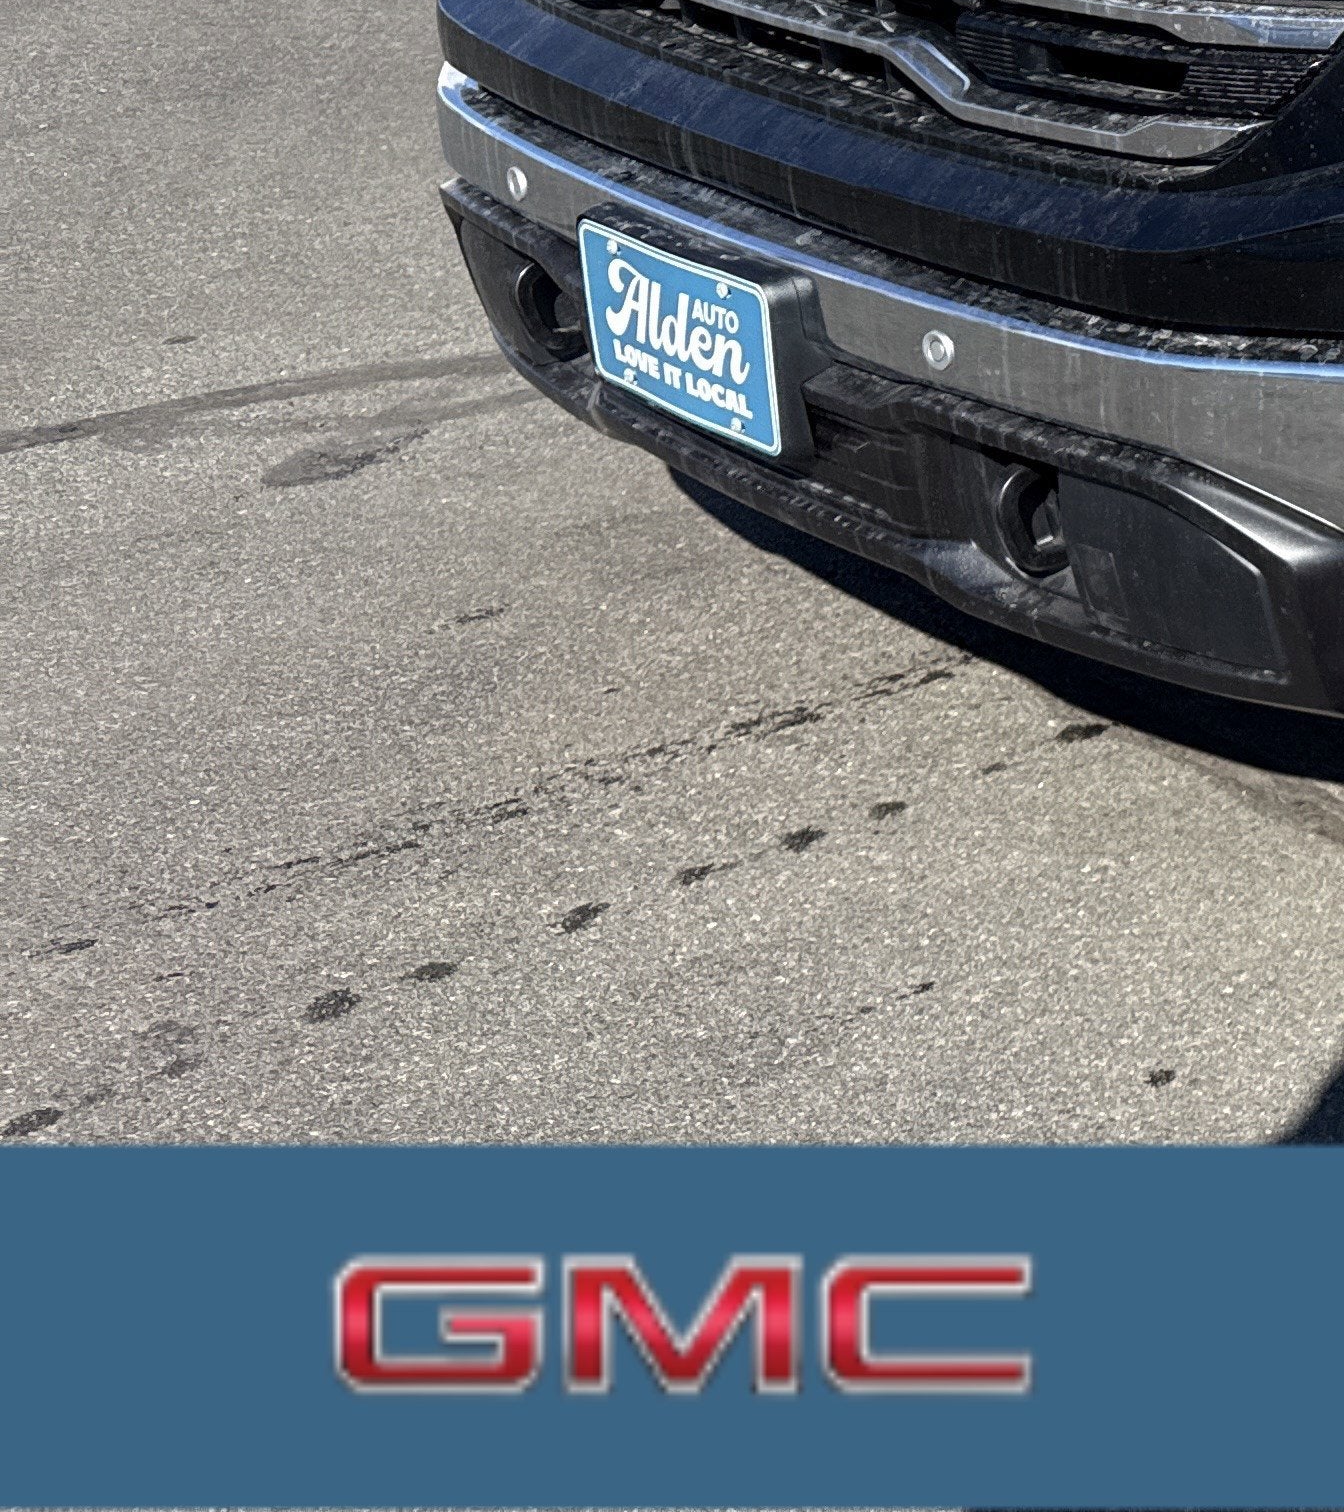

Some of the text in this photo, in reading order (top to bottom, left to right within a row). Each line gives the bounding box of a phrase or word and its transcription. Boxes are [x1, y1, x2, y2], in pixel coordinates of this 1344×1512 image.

[605, 258, 750, 385] Alden
[692, 299, 739, 334] AUTO
[613, 339, 753, 419] LOVE IT LOCAL
